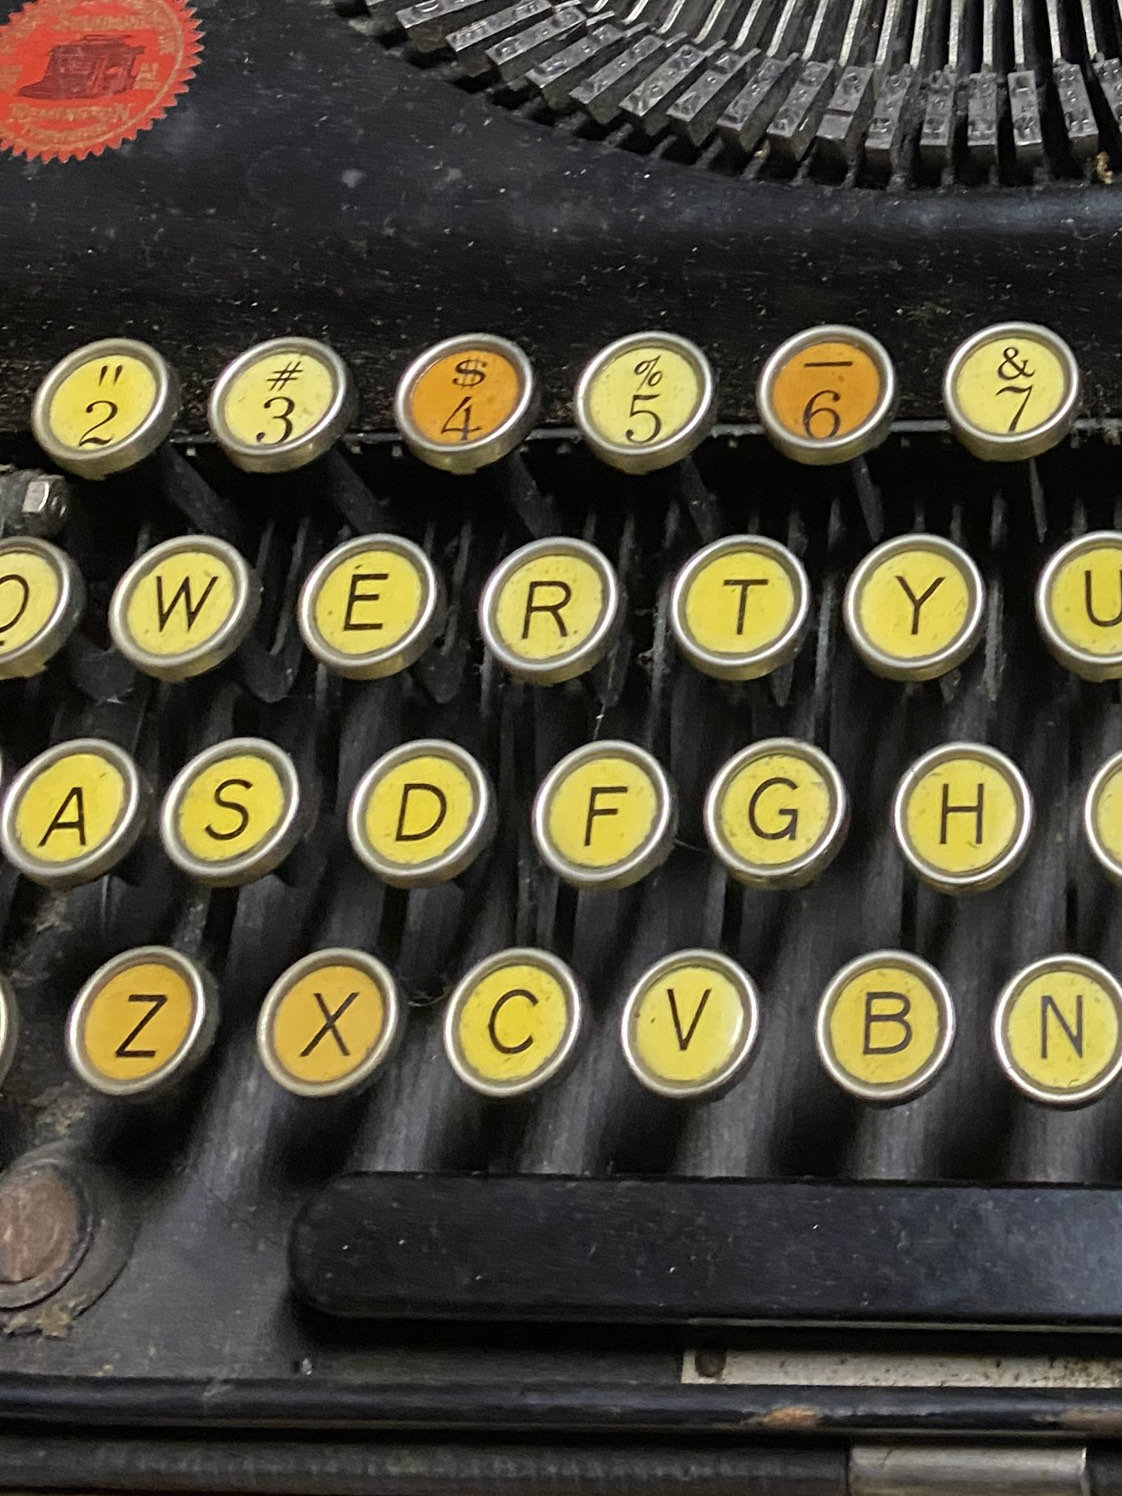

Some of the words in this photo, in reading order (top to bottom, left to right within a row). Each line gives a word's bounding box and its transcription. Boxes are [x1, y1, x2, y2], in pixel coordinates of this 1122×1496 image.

[267, 362, 303, 390] #
[453, 360, 485, 387] $
[634, 356, 662, 386] %
[998, 347, 1034, 380] &
[79, 401, 117, 447] 2
[254, 397, 298, 446] 3
[441, 397, 481, 440] 4
[623, 394, 663, 445] 5
[803, 390, 840, 438] 6
[994, 385, 1034, 434] 7
[157, 576, 218, 632] W
[344, 574, 389, 631] E
[522, 581, 571, 639] R
[724, 579, 768, 635] T
[896, 576, 945, 635] Y
[39, 787, 86, 846] A
[205, 779, 252, 840] S
[396, 783, 447, 841] D
[584, 786, 628, 846] F
[749, 777, 798, 840] G
[940, 784, 984, 844] H
[116, 995, 167, 1057] Z
[300, 993, 359, 1057] X
[488, 989, 538, 1054] C
[667, 989, 711, 1051] V
[863, 992, 912, 1055] B
[1041, 995, 1083, 1059] N
